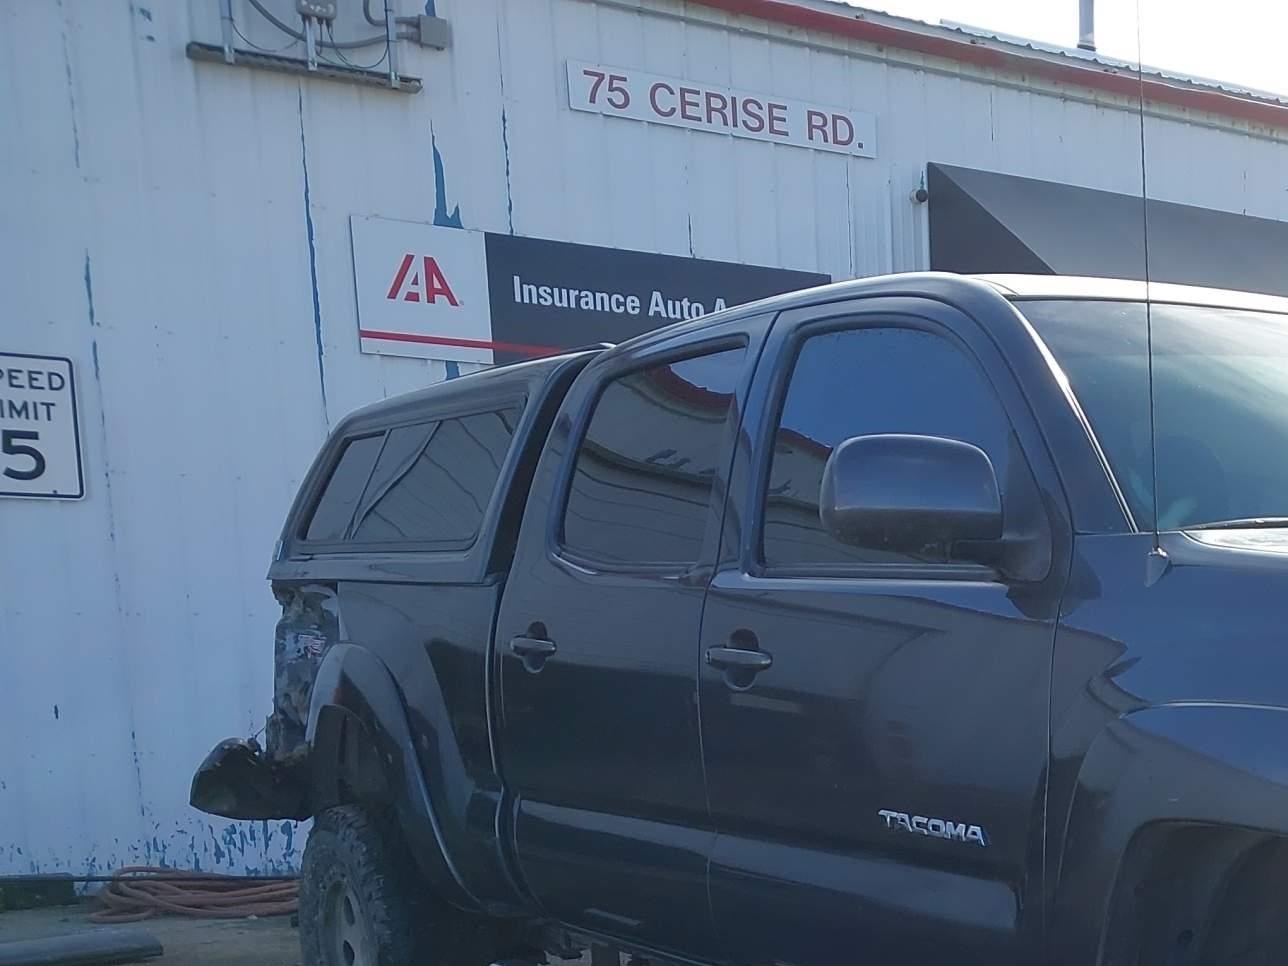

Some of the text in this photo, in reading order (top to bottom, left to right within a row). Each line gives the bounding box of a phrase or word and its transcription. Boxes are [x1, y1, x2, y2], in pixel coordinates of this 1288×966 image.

[583, 69, 863, 149] 75 CERISE RD.
[513, 275, 640, 315] Insurance
[648, 290, 705, 320] Auto
[0, 368, 65, 391] EED
[2, 429, 46, 480] 5
[878, 809, 985, 846] TACOMA
